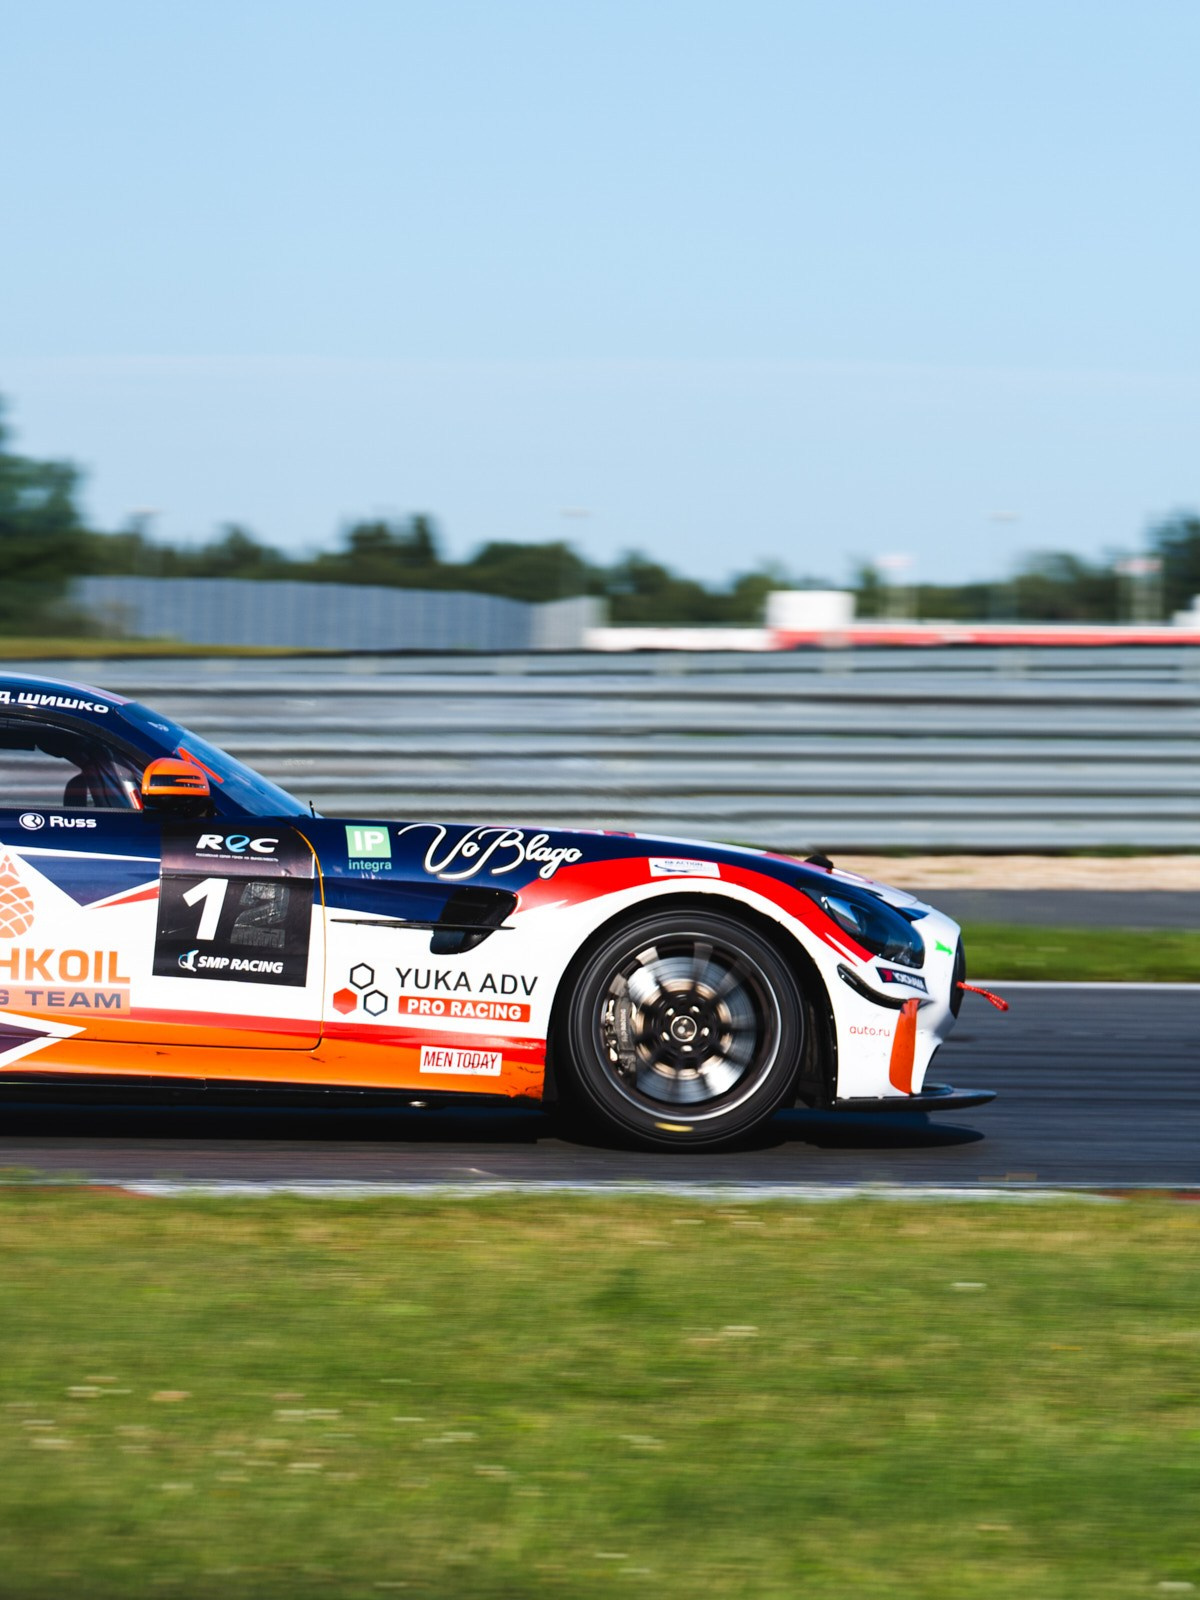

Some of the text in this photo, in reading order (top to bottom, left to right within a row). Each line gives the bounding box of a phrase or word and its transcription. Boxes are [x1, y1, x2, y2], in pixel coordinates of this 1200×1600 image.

[49, 815, 97, 829] Russ
[354, 831, 385, 851] IP
[348, 859, 392, 873] integra
[198, 954, 283, 975] SMP RACING
[396, 967, 538, 996] YUKA ADV
[25, 990, 122, 1009] TEAM
[407, 998, 522, 1020] PRO RACING
[849, 1024, 891, 1037] auto.ru
[423, 1051, 498, 1070] MEN TODAY
